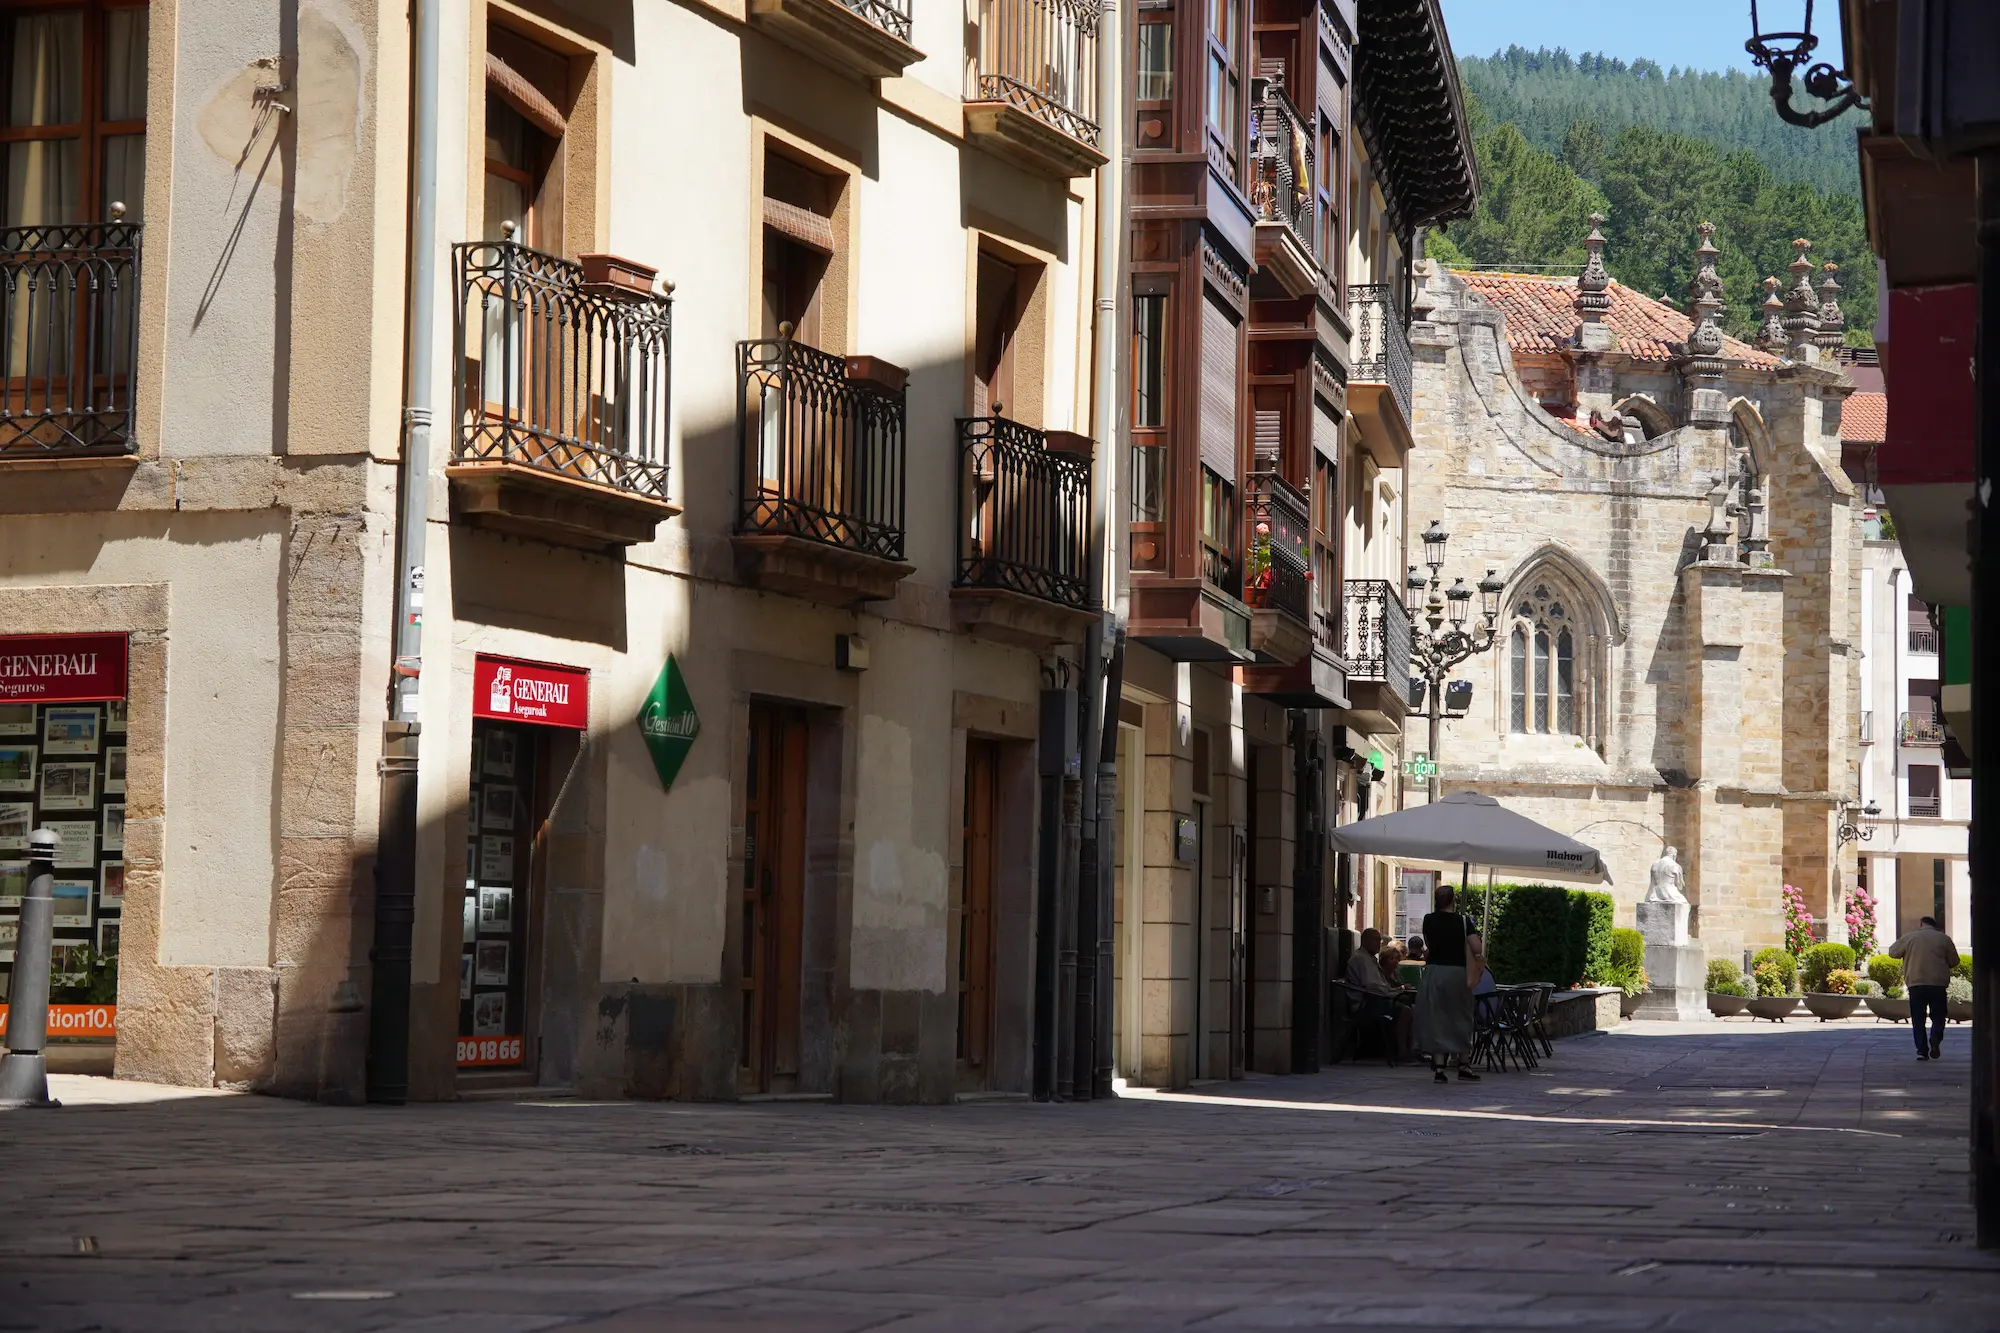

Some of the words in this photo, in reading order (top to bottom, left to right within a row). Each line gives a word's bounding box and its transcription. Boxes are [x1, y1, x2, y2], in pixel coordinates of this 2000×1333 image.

[0, 653, 98, 678] GENERALI
[513, 678, 568, 705] GENERALI
[513, 701, 547, 718] Aseguroak
[1414, 763, 1436, 775] DOM
[1546, 850, 1583, 861] Mahou
[479, 1040, 498, 1061] 18
[499, 1039, 520, 1060] 66
